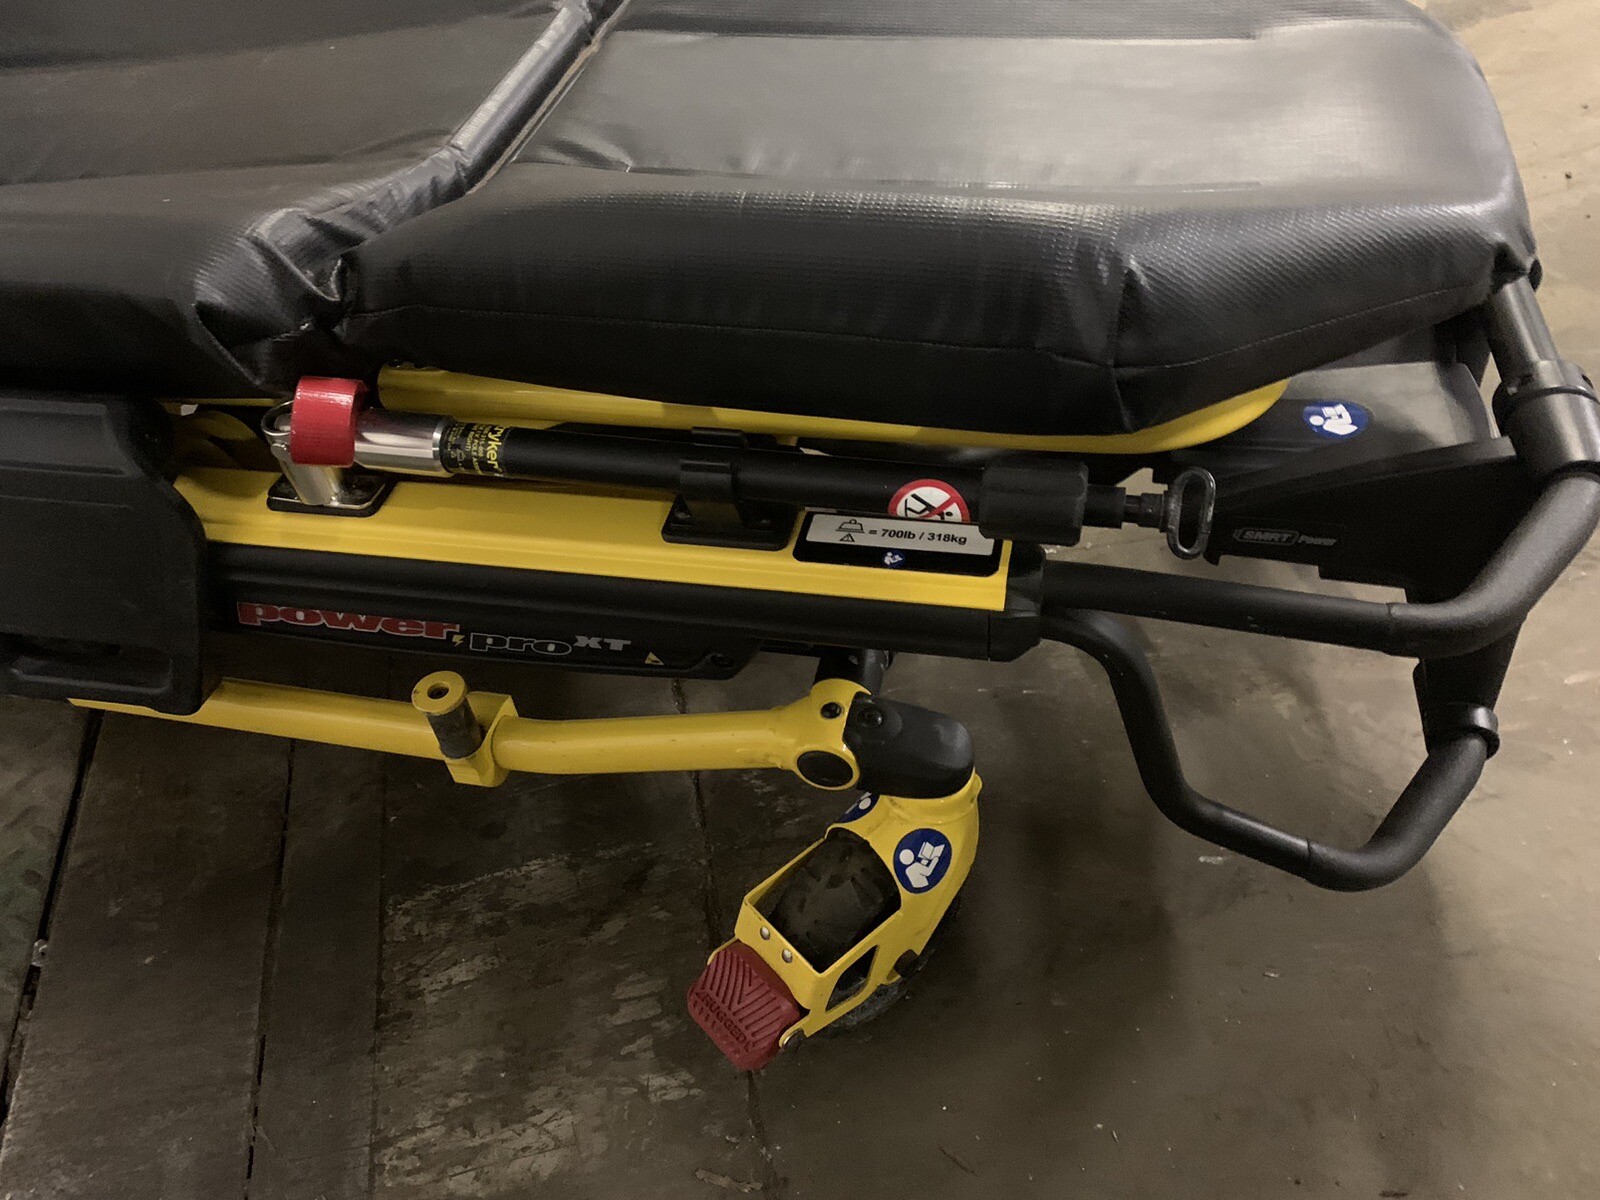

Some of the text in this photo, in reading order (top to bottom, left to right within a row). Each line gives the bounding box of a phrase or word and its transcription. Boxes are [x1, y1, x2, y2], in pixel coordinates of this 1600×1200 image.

[486, 425, 505, 469] ryker
[881, 528, 916, 540] 700lb
[927, 532, 968, 545] 318kg
[236, 601, 632, 655] power pro XT
